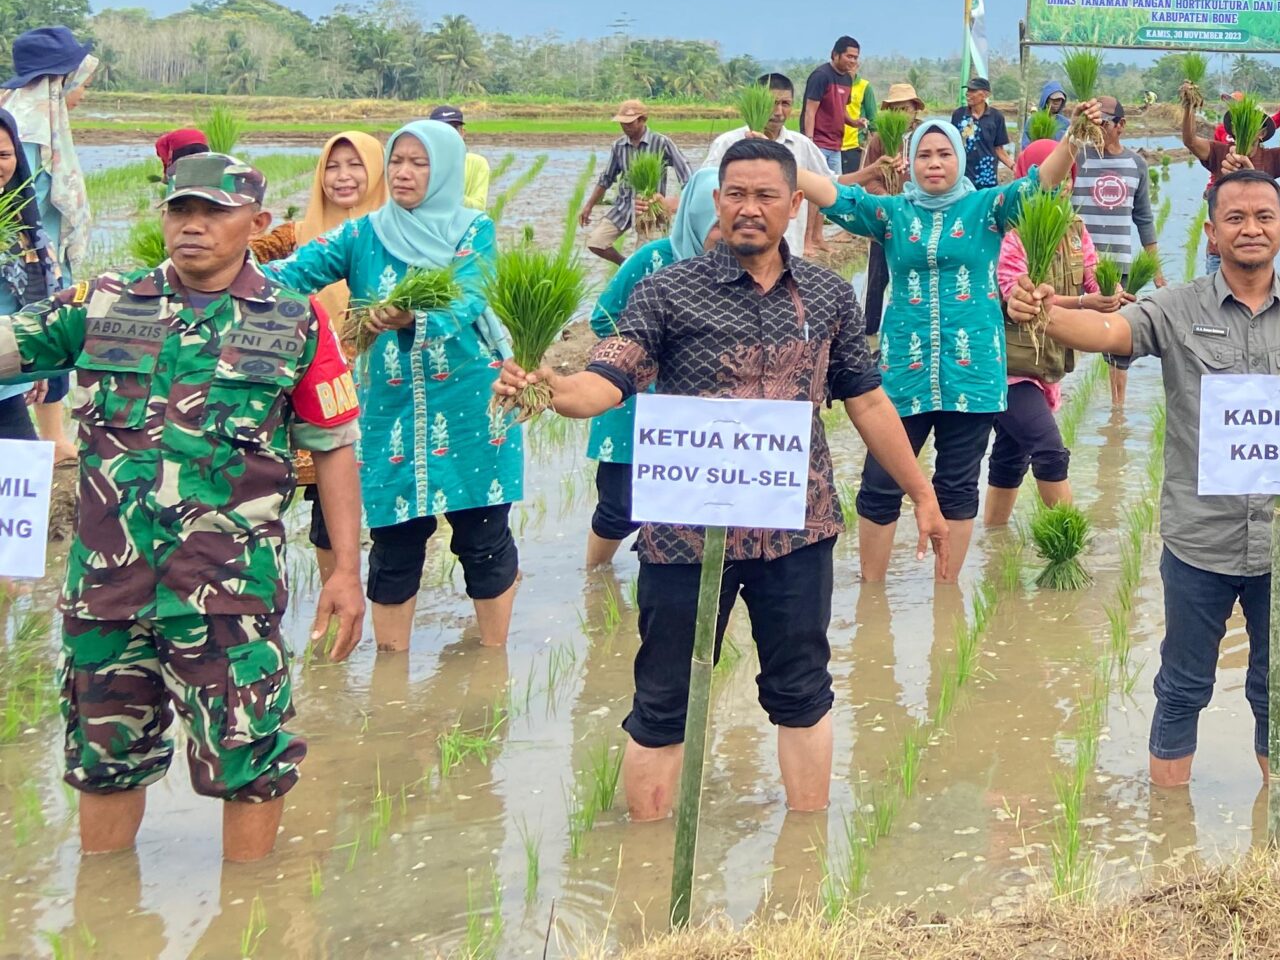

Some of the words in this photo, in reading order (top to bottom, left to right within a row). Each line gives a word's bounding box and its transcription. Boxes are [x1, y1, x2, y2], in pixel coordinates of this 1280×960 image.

[1176, 0, 1249, 11] HORTIKULTURA
[1253, 1, 1273, 12] DAN
[1151, 11, 1209, 23] KABUPATEN
[1212, 13, 1238, 24] BONE
[1174, 30, 1183, 38] 30
[1183, 30, 1223, 39] NOVEMBER
[1224, 32, 1242, 40] 2023
[229, 332, 262, 348] TNI
[270, 340, 298, 353] AD
[639, 428, 724, 449] KETUA
[733, 432, 803, 452] KTNA
[637, 463, 699, 482] PROV
[706, 467, 801, 487] SUL-SEL
